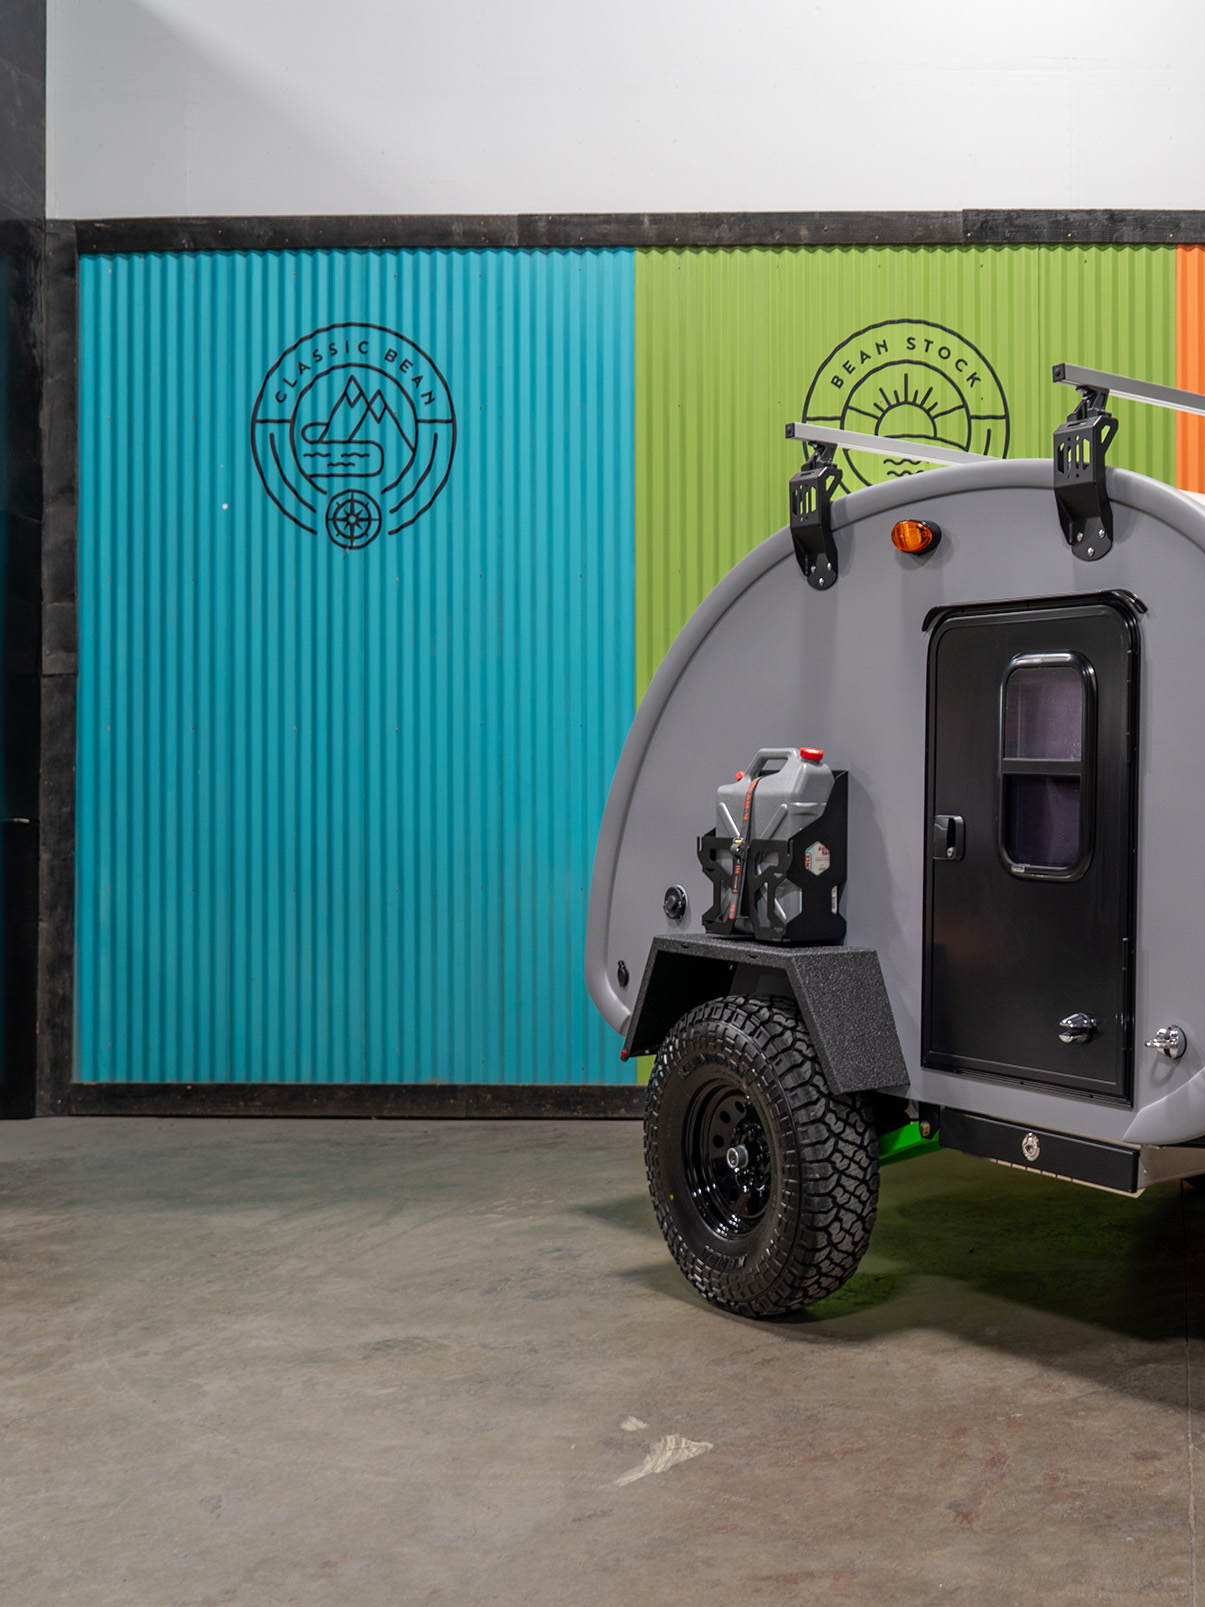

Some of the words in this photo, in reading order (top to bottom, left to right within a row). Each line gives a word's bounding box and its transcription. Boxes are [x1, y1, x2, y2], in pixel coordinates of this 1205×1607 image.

[274, 340, 370, 404] CLASSIC
[384, 348, 436, 405] BEAN
[830, 339, 889, 389] BEAN
[906, 336, 982, 388] STOCK
